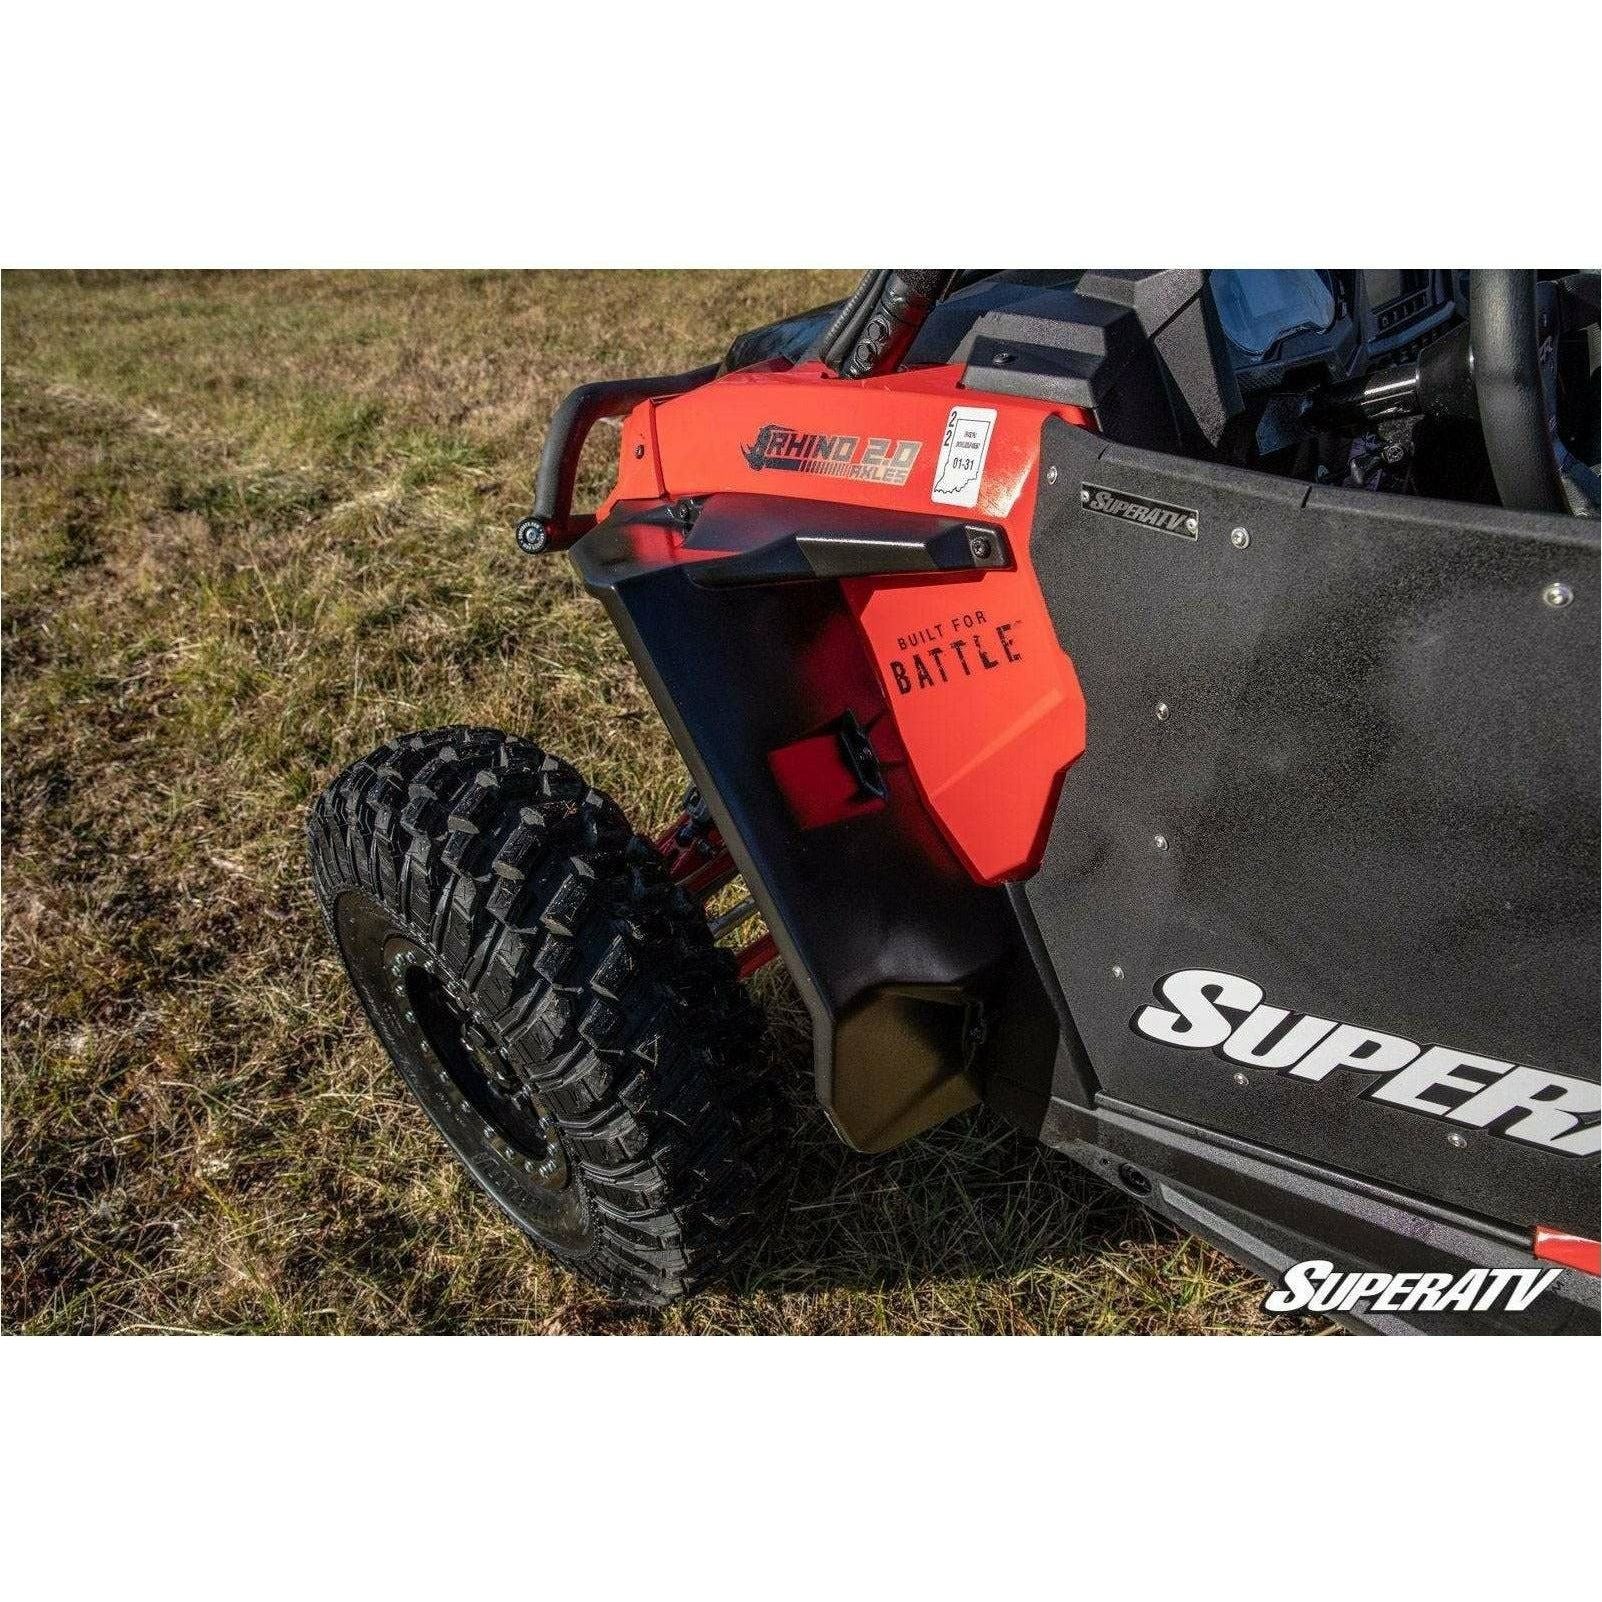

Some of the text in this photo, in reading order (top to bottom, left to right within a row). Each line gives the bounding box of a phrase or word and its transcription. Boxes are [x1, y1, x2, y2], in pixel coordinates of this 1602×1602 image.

[766, 431, 923, 468] RHINO 2.0
[952, 457, 975, 471] 01-31
[850, 464, 909, 484] AXLES
[1090, 491, 1188, 530] SUPERATV
[897, 610, 987, 650] BUILT FOR
[890, 623, 1022, 694] BATTLE
[1132, 968, 1601, 1157] SUPER
